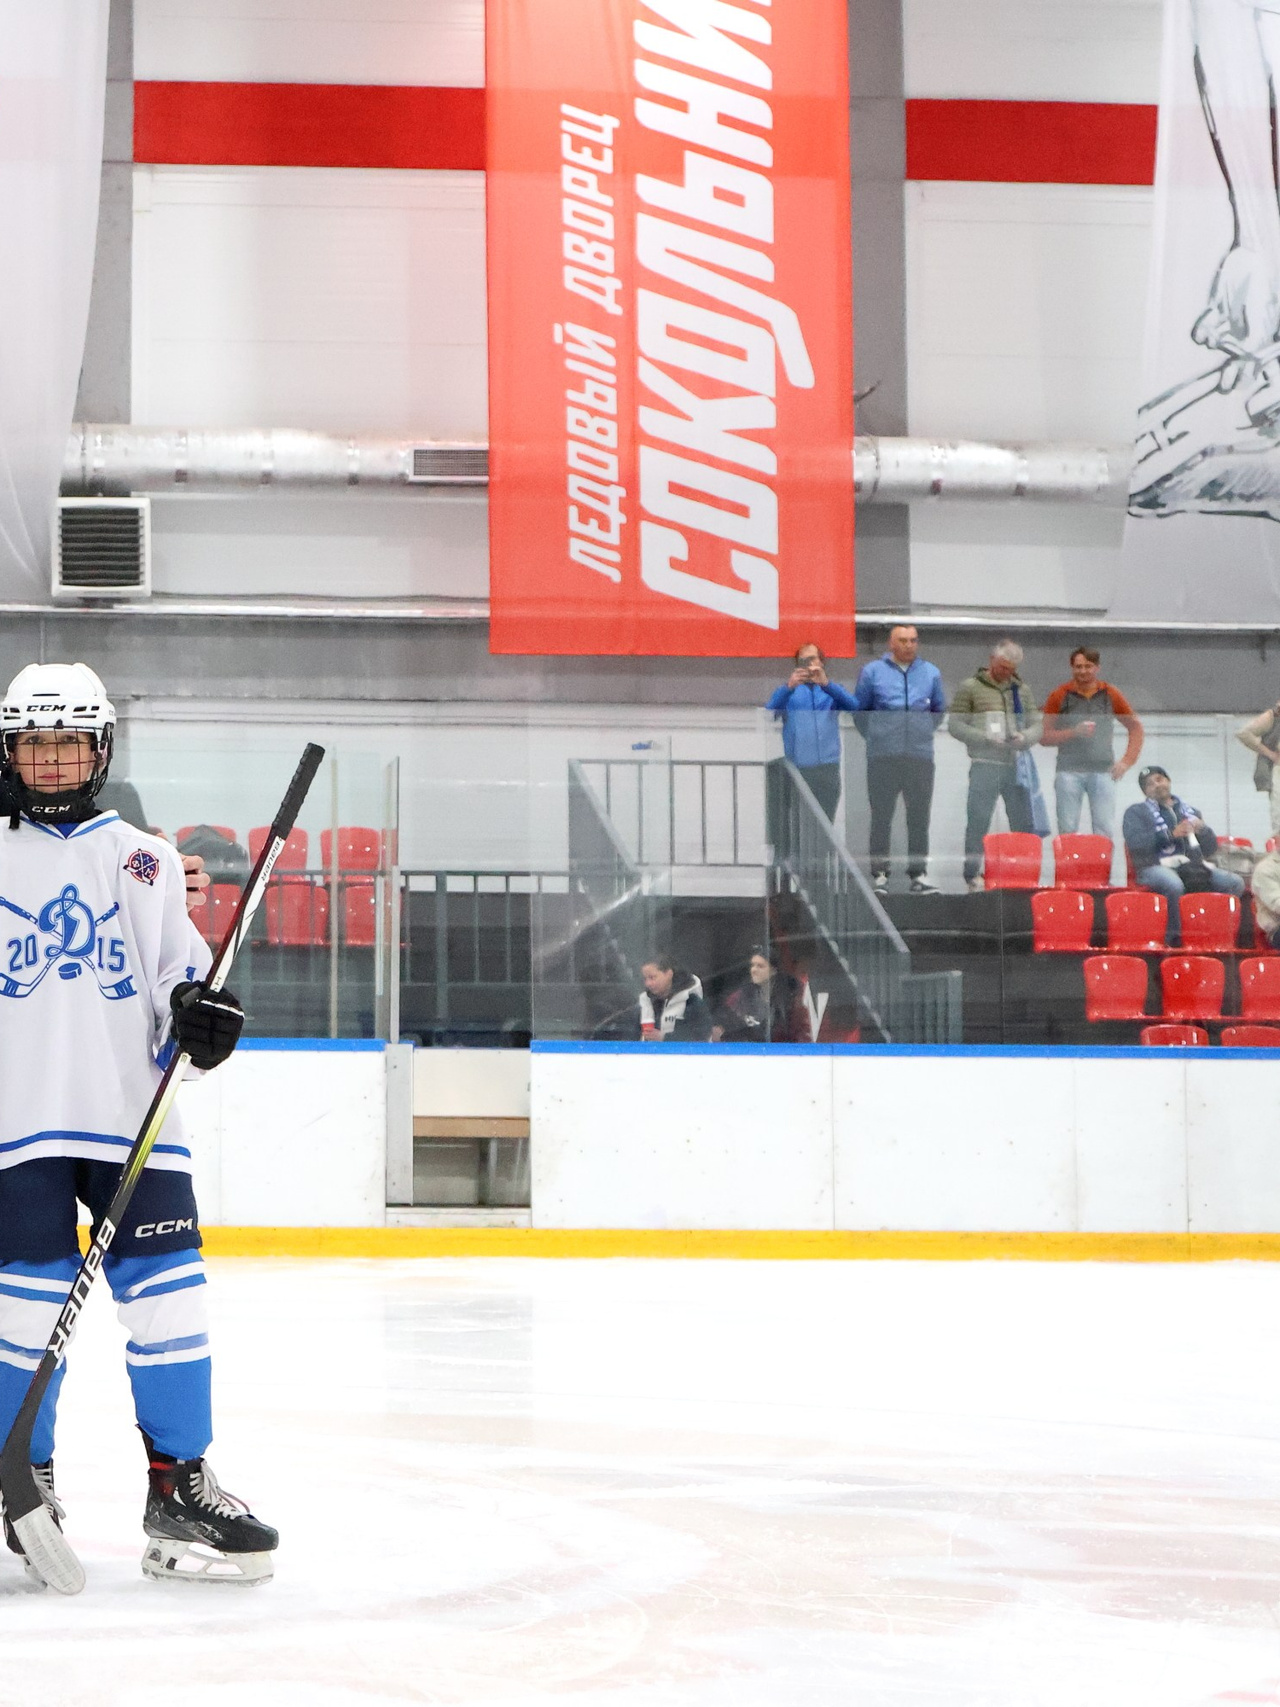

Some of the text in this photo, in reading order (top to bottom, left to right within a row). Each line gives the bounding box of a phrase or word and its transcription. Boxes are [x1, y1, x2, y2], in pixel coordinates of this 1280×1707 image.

[633, 0, 816, 630] СОКОЛЬНИ
[554, 103, 626, 583] ЛЕДОВЫЙ ДВОРЕЦ
[32, 805, 70, 813] CCM
[7, 933, 38, 973] 20
[97, 936, 126, 973] 15
[134, 1218, 194, 1239] CCM
[48, 1216, 117, 1359] BAUER
